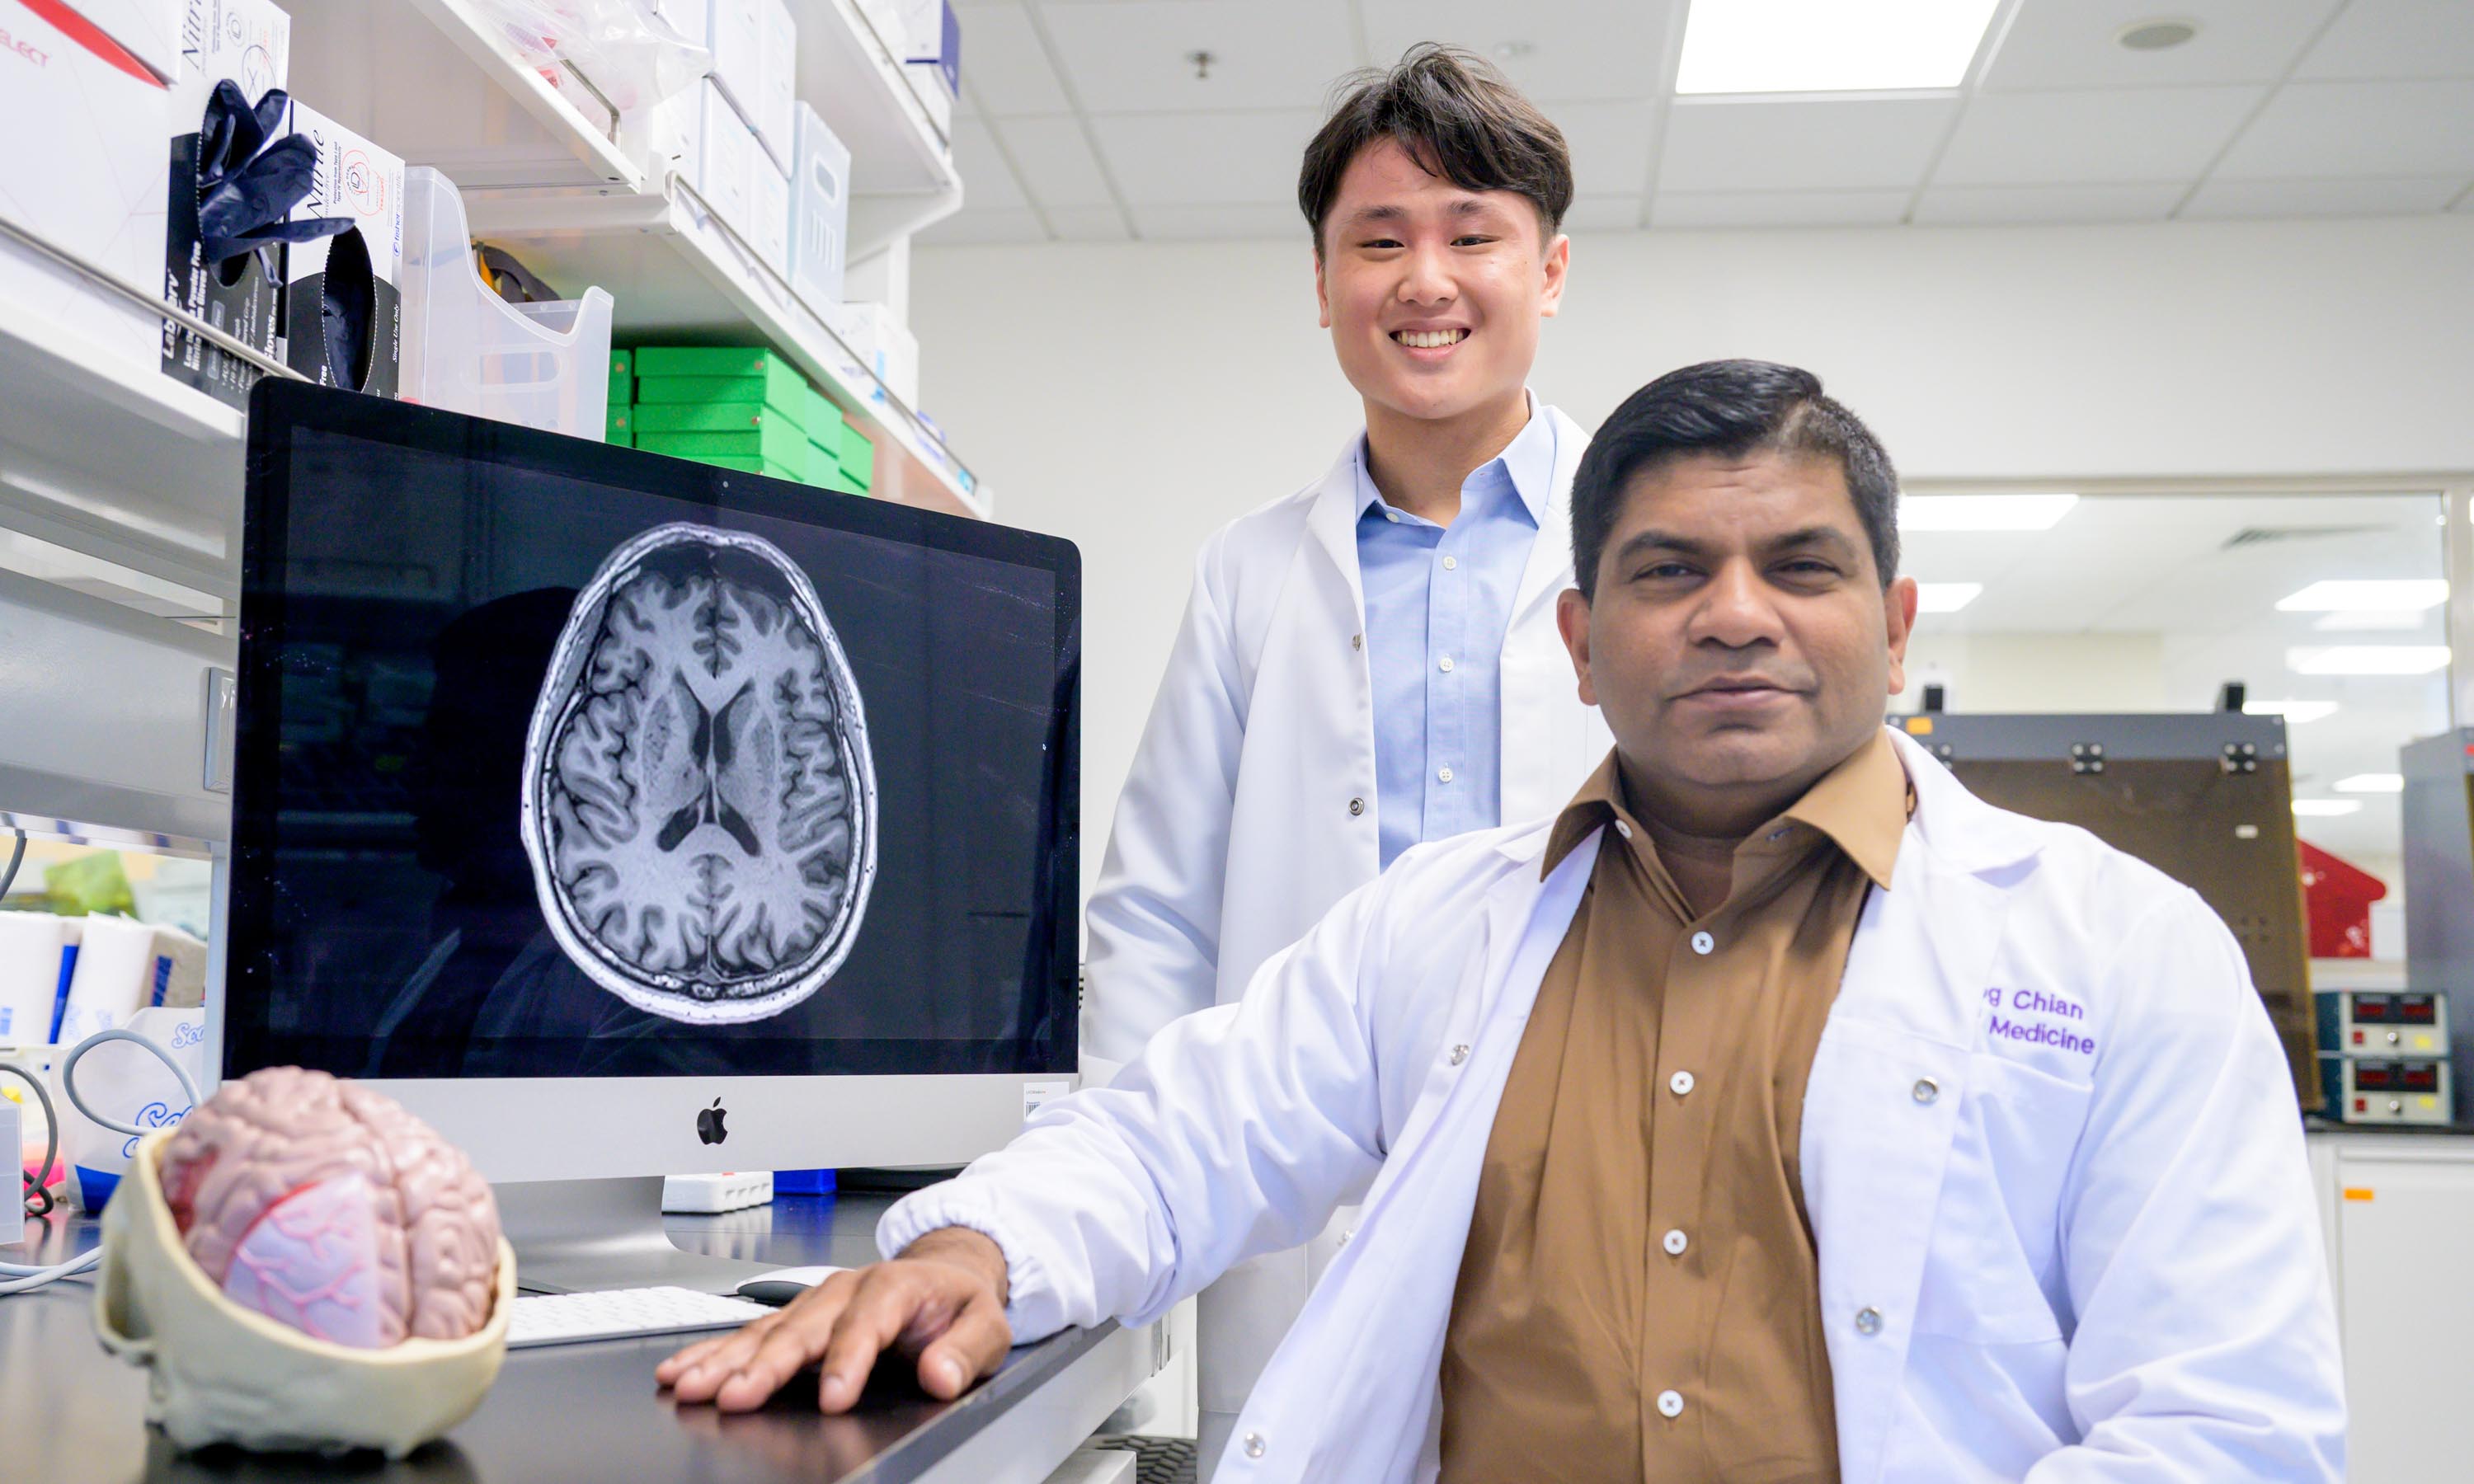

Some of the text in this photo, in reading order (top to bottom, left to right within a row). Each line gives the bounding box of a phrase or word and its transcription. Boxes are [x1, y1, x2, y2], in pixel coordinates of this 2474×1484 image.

[190, 241, 202, 267] Free
[188, 266, 200, 308] Powder
[197, 269, 208, 306] Gloves
[162, 272, 179, 359] Laberv
[183, 345, 192, 368] Low
[319, 364, 327, 387] Free
[1982, 988, 2084, 1021] g Chian
[1988, 1014, 2095, 1055] Medicine
